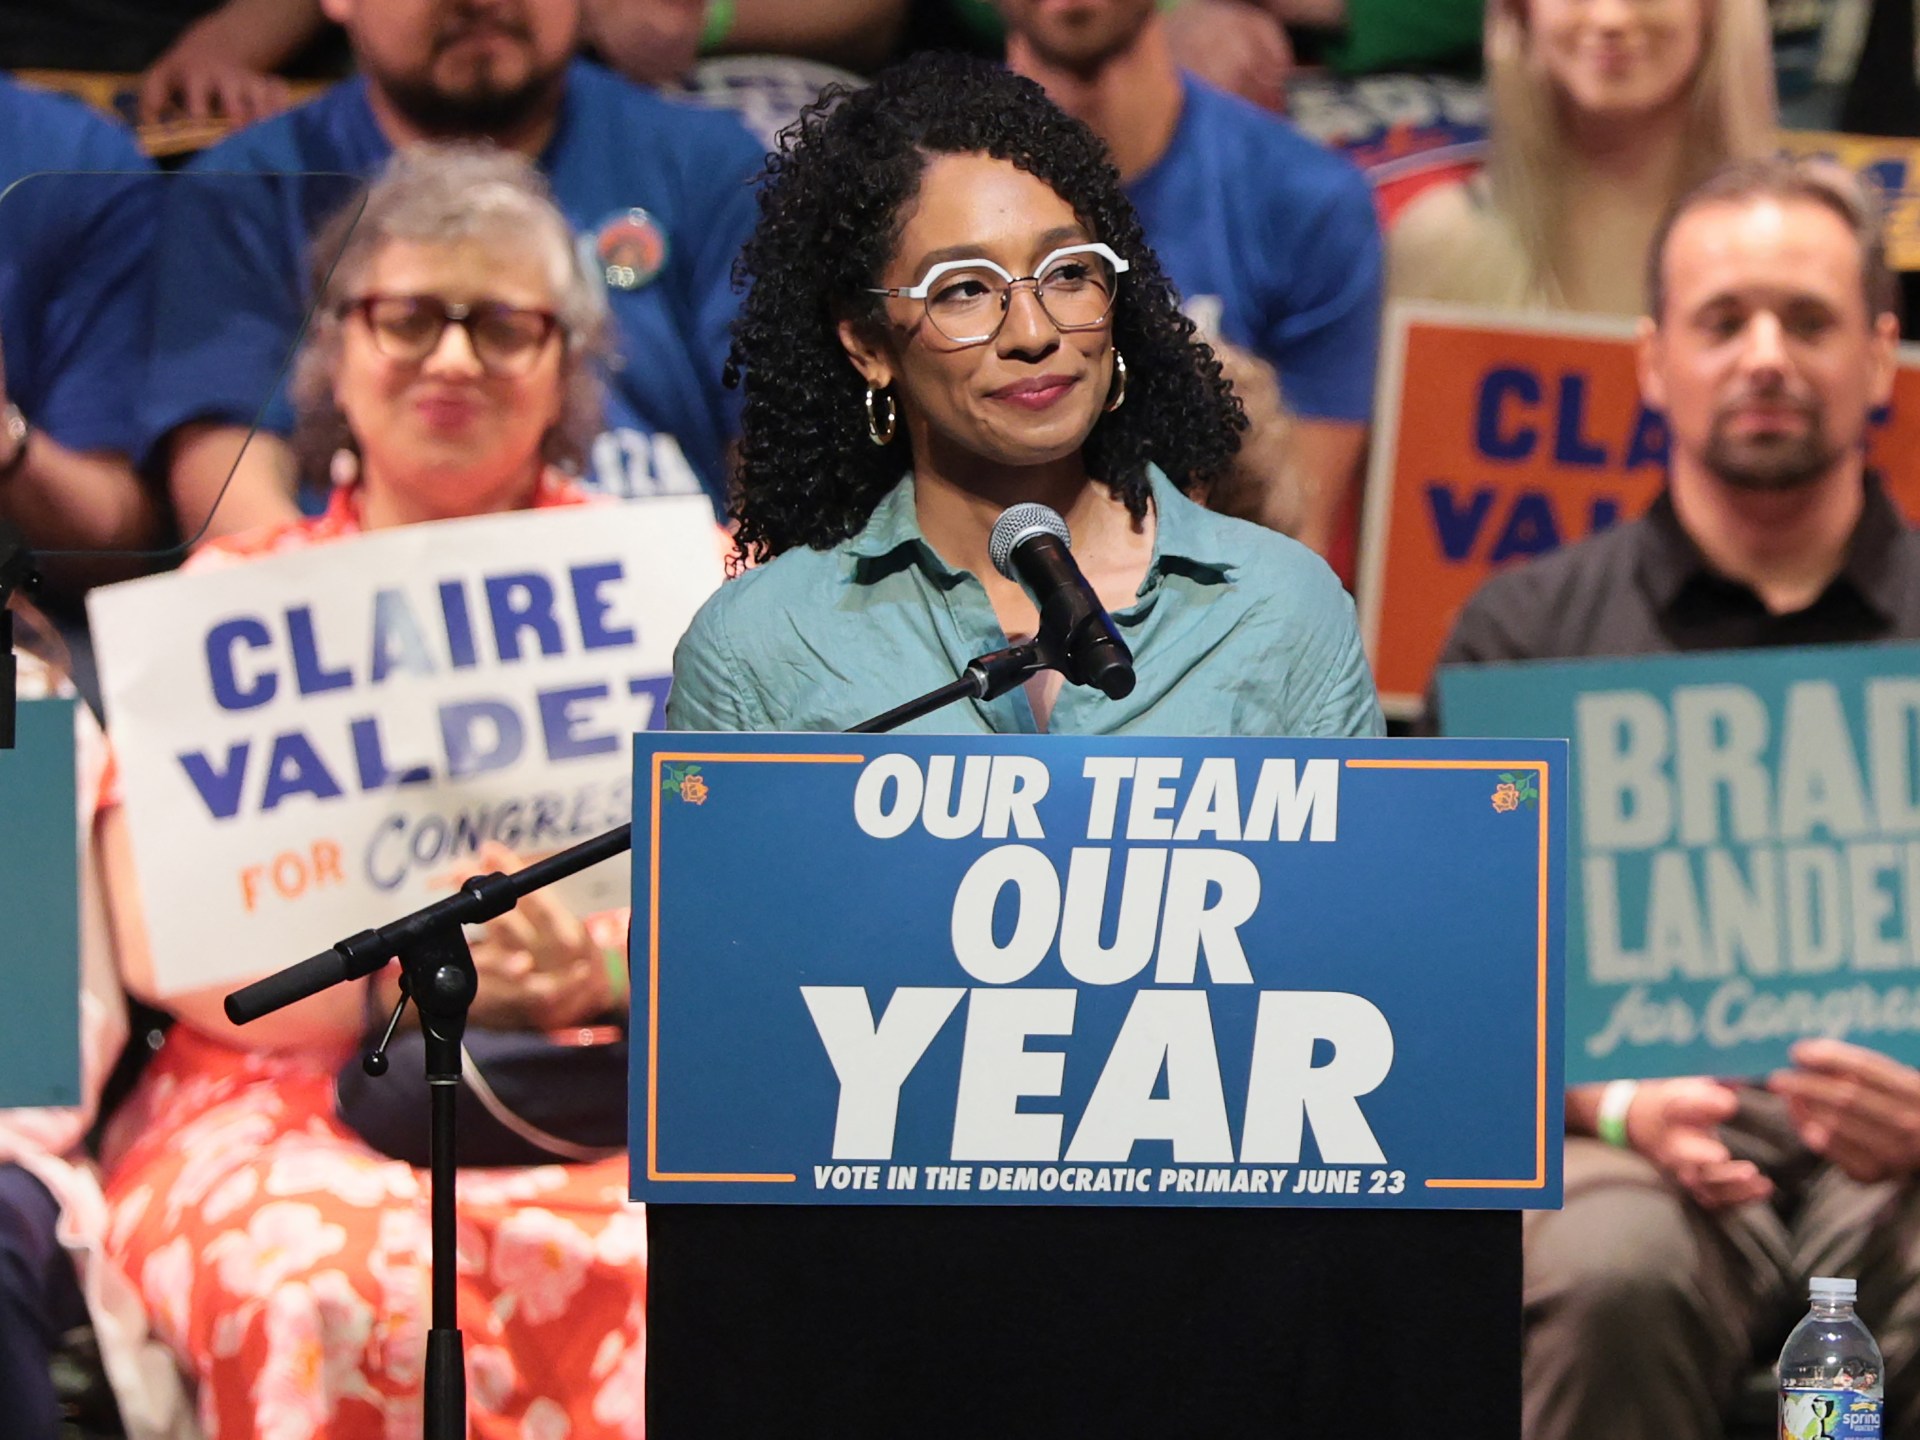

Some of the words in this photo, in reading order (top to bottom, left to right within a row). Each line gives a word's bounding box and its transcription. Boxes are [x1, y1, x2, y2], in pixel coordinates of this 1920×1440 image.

[204, 560, 637, 711] CLAIRE
[853, 753, 1050, 840] OUR
[1082, 756, 1340, 842] TEAM
[239, 840, 347, 914] FOR
[951, 844, 1261, 986] OUR
[1582, 843, 1920, 983] LANDE
[1585, 982, 1695, 1057] for
[1703, 978, 1920, 1048] Congre
[799, 985, 1394, 1165] YEAR
[813, 1165, 880, 1190] VOTE
[886, 1165, 918, 1190] IN
[924, 1166, 974, 1191] THE
[978, 1166, 1152, 1193] DEMOCRATIC
[1157, 1168, 1289, 1194] PRIMARY
[1292, 1169, 1362, 1194] JUNE
[1367, 1169, 1406, 1194] 23
[1842, 1409, 1881, 1430] spring
